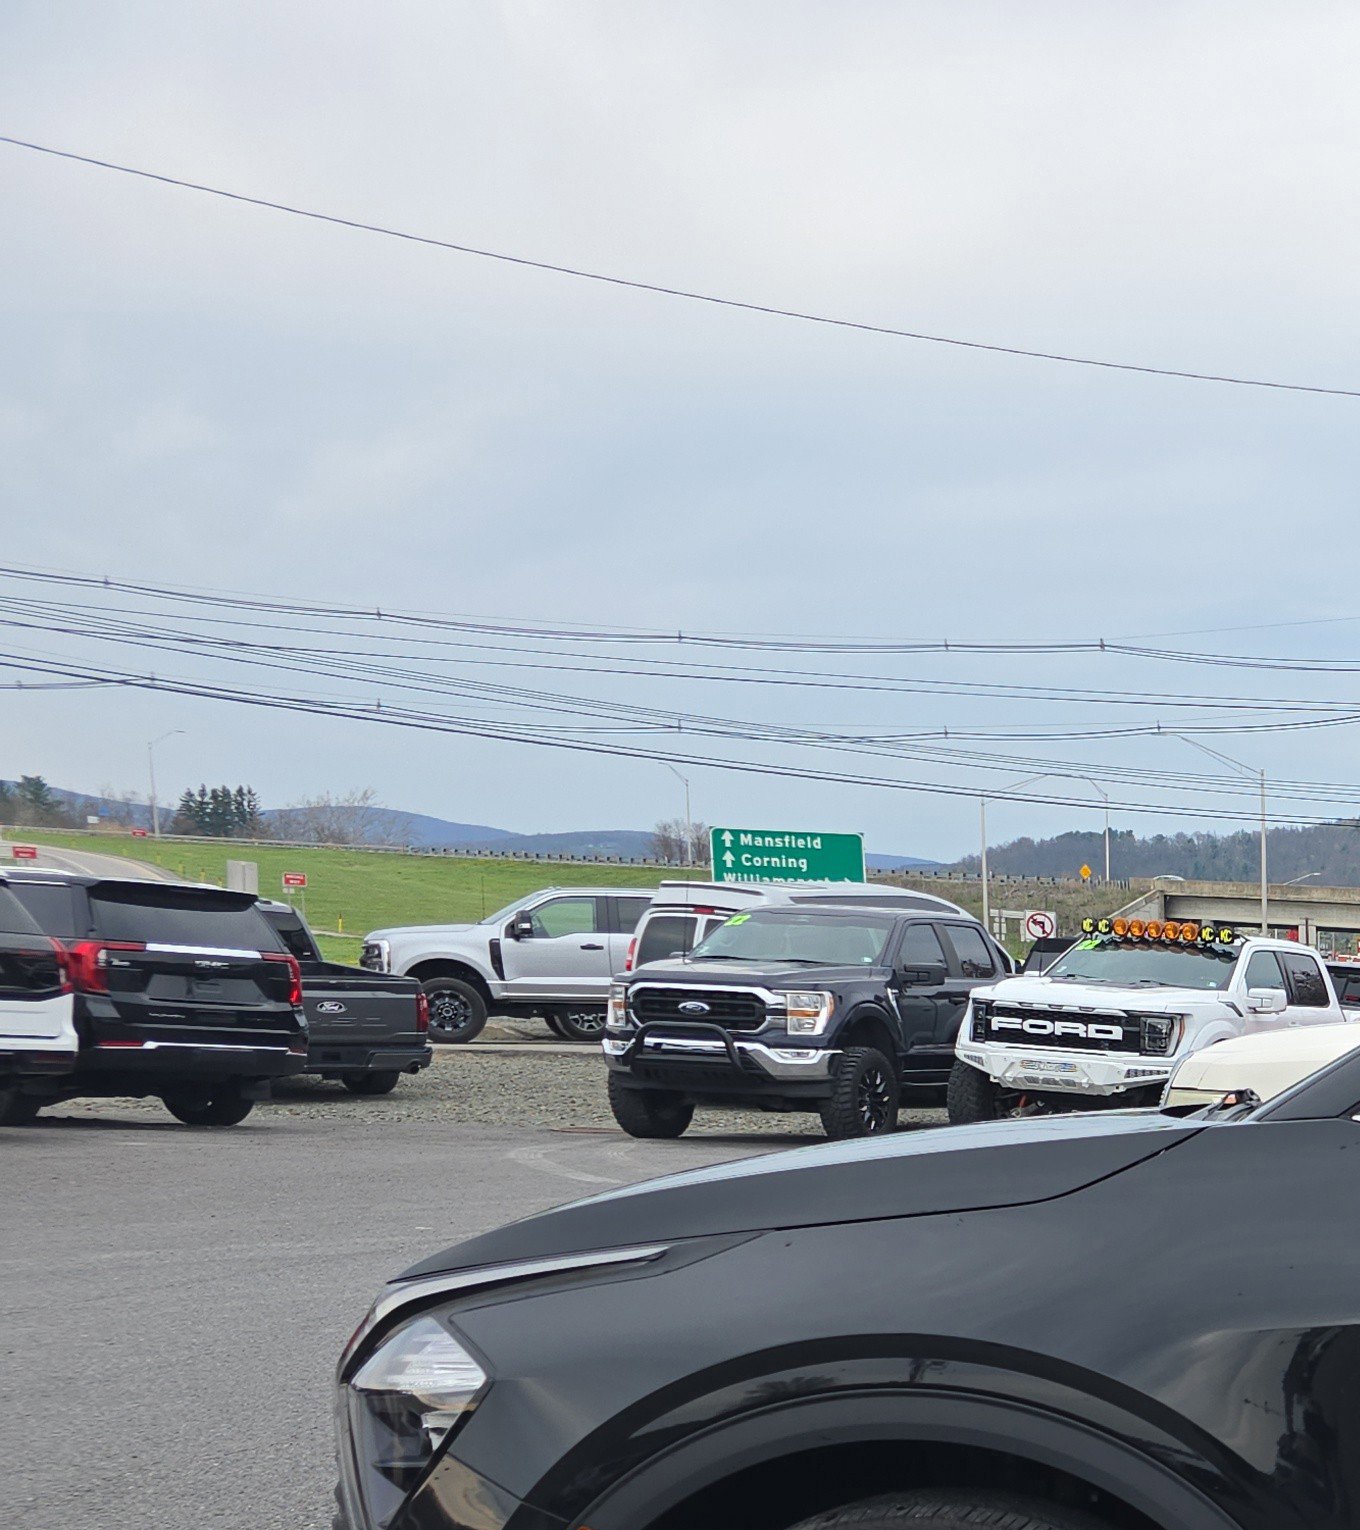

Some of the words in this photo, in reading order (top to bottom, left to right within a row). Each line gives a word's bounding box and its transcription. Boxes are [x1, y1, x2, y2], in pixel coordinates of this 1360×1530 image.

[740, 833, 822, 849] Mansfield
[741, 854, 808, 872] Corning
[991, 1017, 1123, 1040] FORD
